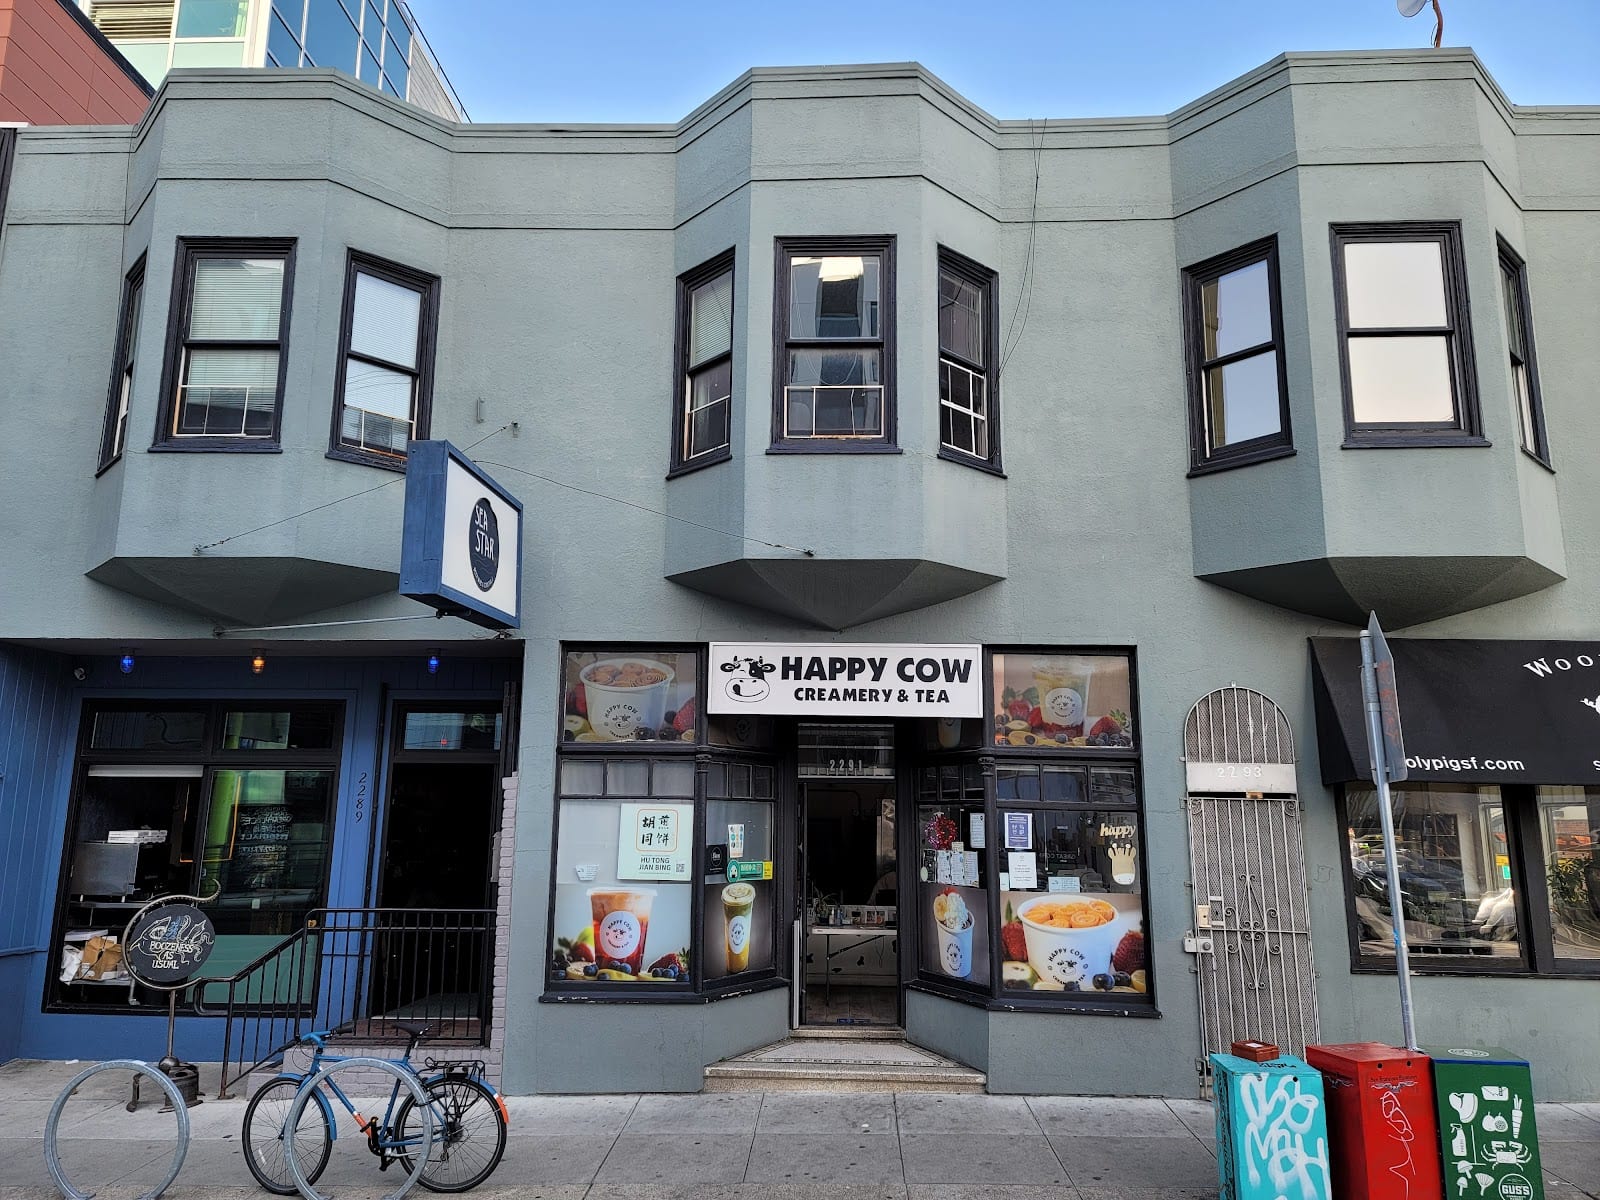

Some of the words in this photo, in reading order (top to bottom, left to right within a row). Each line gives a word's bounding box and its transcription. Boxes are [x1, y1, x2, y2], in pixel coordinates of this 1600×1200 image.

[474, 505, 489, 531] SEA
[475, 530, 495, 561] STAR
[781, 656, 888, 682] HAPPY
[896, 657, 973, 683] COW
[793, 687, 893, 702] CREAMERY
[896, 689, 909, 702] &
[915, 689, 950, 703] TEA
[829, 759, 862, 772] 2291
[1216, 766, 1262, 778] 2293
[355, 771, 367, 824] 2289
[1100, 822, 1136, 839] happy
[162, 951, 175, 960] AS
[1048, 947, 1067, 962] HAPPY
[1070, 948, 1085, 961] COW
[152, 960, 180, 970] USUAL
[1501, 1184, 1531, 1196] GUS'S
